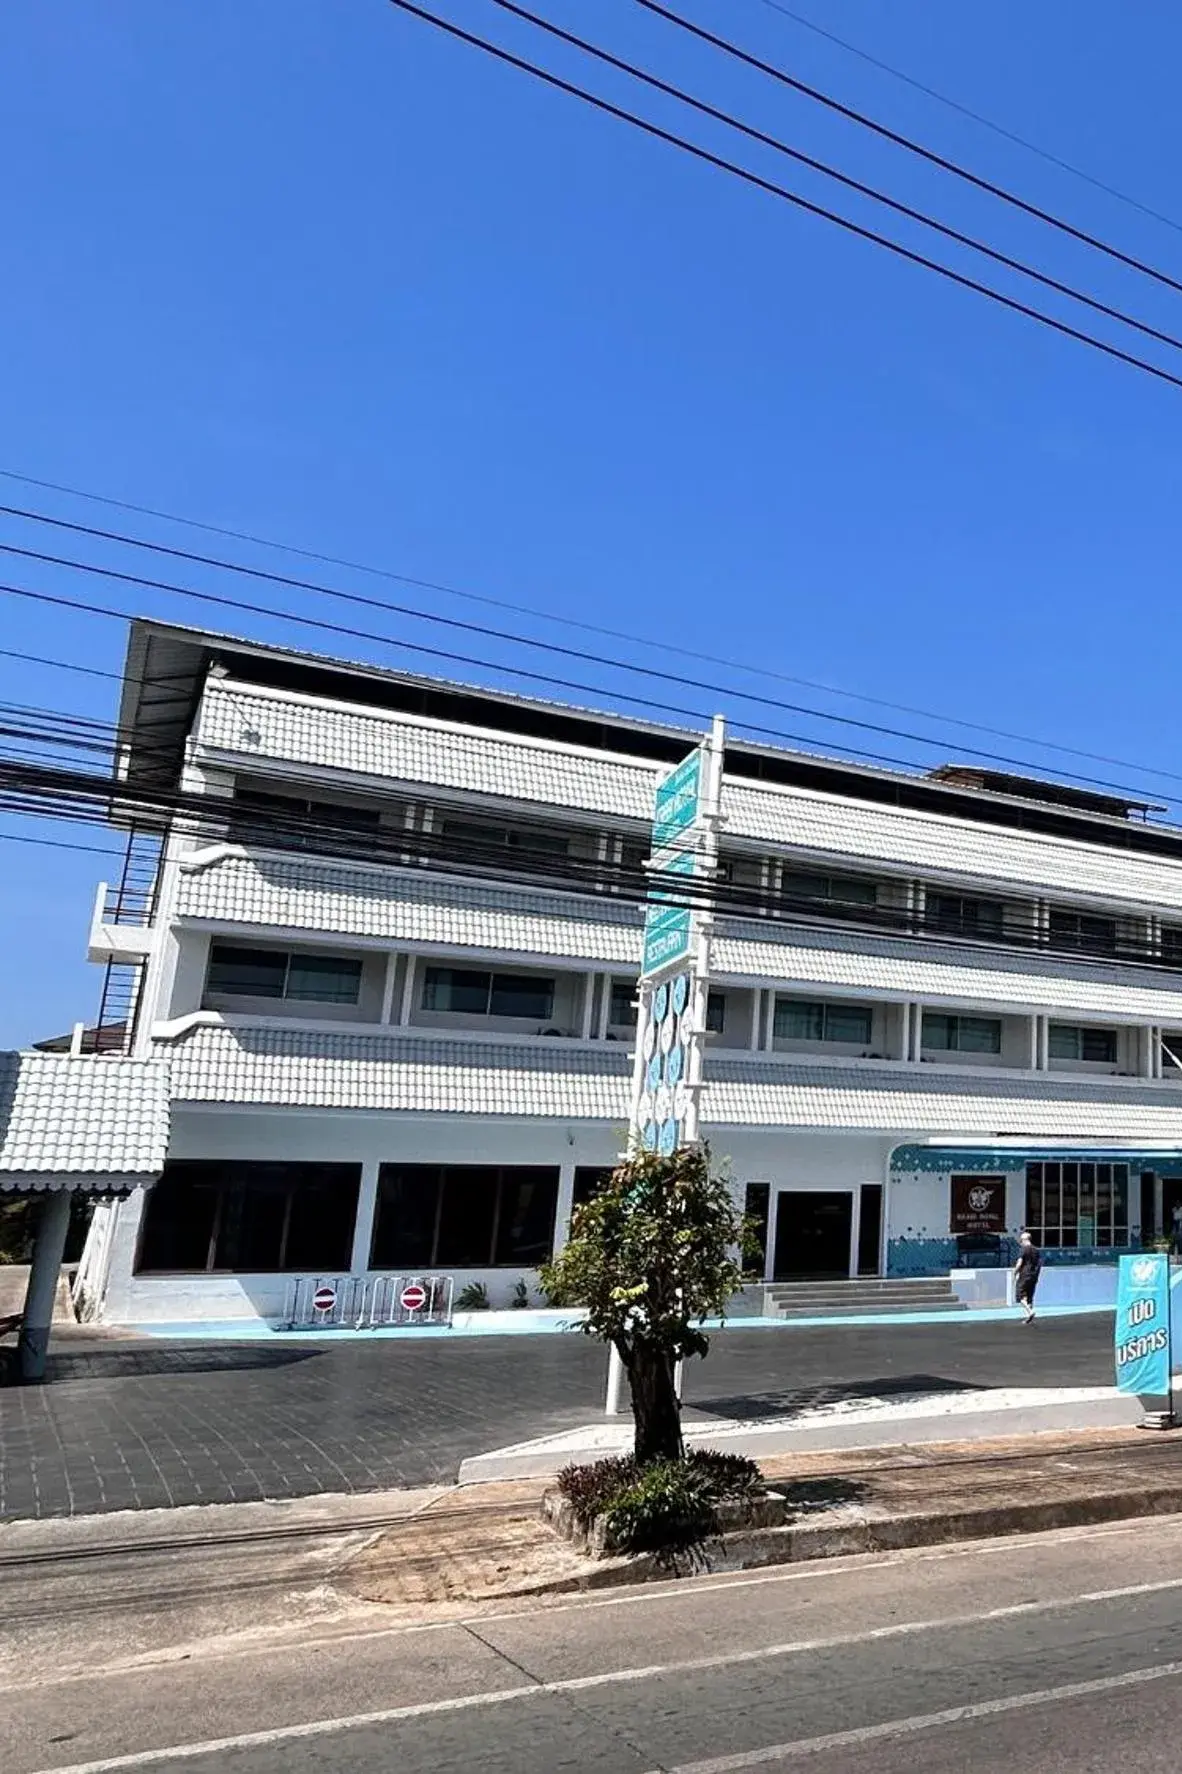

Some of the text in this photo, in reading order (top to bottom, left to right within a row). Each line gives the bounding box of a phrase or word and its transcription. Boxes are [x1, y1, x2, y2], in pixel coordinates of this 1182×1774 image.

[1128, 1298, 1155, 1327] เปิด
[1117, 1328, 1168, 1366] บริการ
